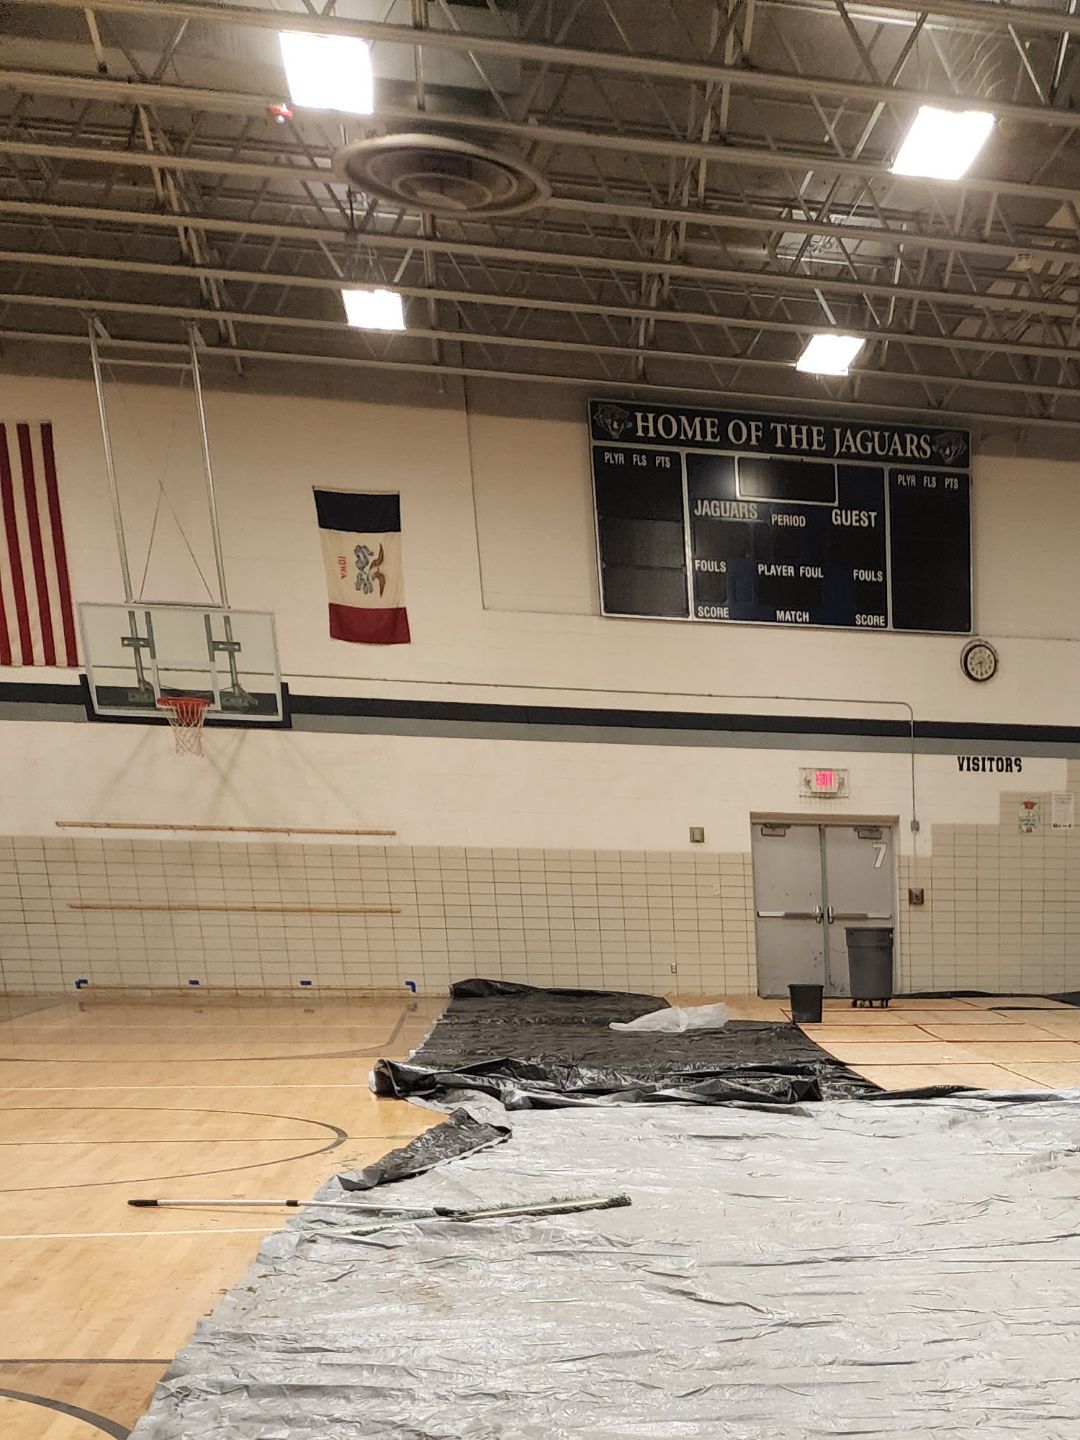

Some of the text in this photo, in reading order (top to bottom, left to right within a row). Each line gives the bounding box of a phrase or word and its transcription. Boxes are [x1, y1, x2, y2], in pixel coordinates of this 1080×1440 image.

[634, 411, 932, 460] HOME OF THE JAGUARS
[604, 451, 671, 469] PLYR FLS PTS
[897, 474, 959, 490] PLYR FLS PTS
[694, 499, 758, 520] JAGUARS
[771, 513, 807, 527] PERIOD
[831, 508, 877, 528] GUEST
[338, 556, 347, 579] IOWA
[694, 559, 727, 573] FOULS
[757, 563, 824, 579] PLAYER FOUL
[853, 568, 883, 582] FOULS
[697, 606, 730, 619] SCORE
[776, 609, 810, 623] MATCH
[855, 613, 886, 627] SCORE
[956, 755, 1023, 773] VISITORS
[872, 843, 887, 868] 7
